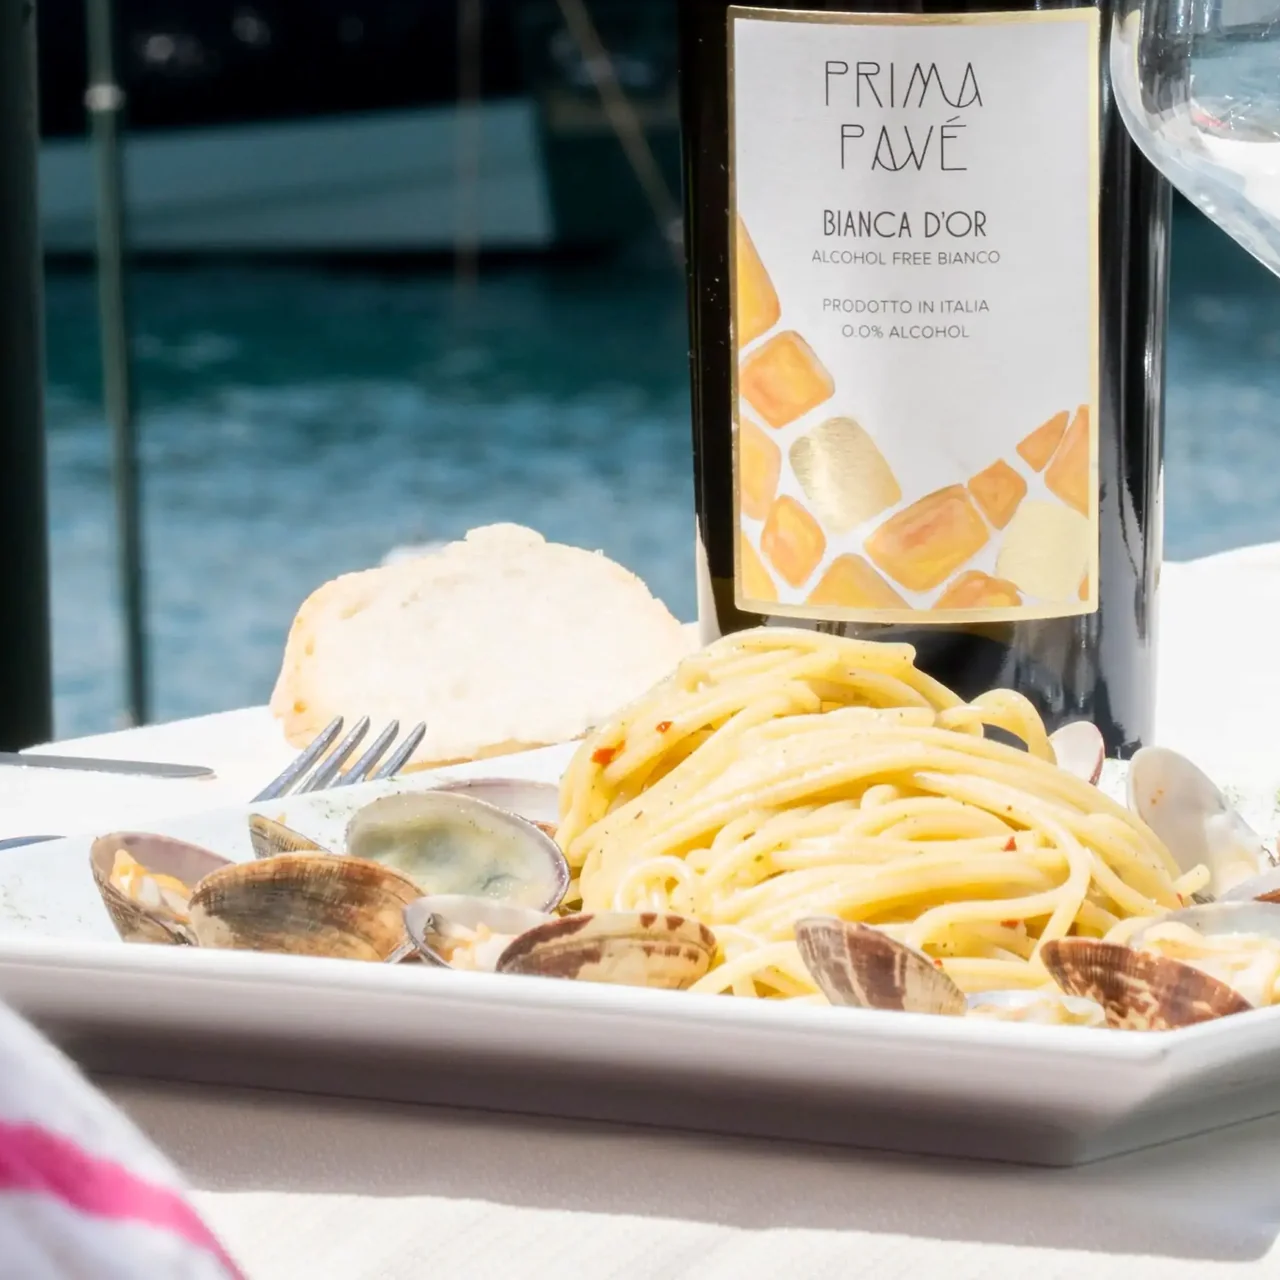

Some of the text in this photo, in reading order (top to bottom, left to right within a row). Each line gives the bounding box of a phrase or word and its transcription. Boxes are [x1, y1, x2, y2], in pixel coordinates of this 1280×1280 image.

[825, 60, 983, 109] PRIMA
[840, 115, 968, 172] PAVÉ
[823, 209, 987, 239] BIANCA D'OR
[811, 249, 1001, 266] ALCOHOL FREE BIANCO
[822, 298, 990, 314] PRODOTTO IN ITALIA
[841, 323, 970, 340] 0.0% ALCOHOL
